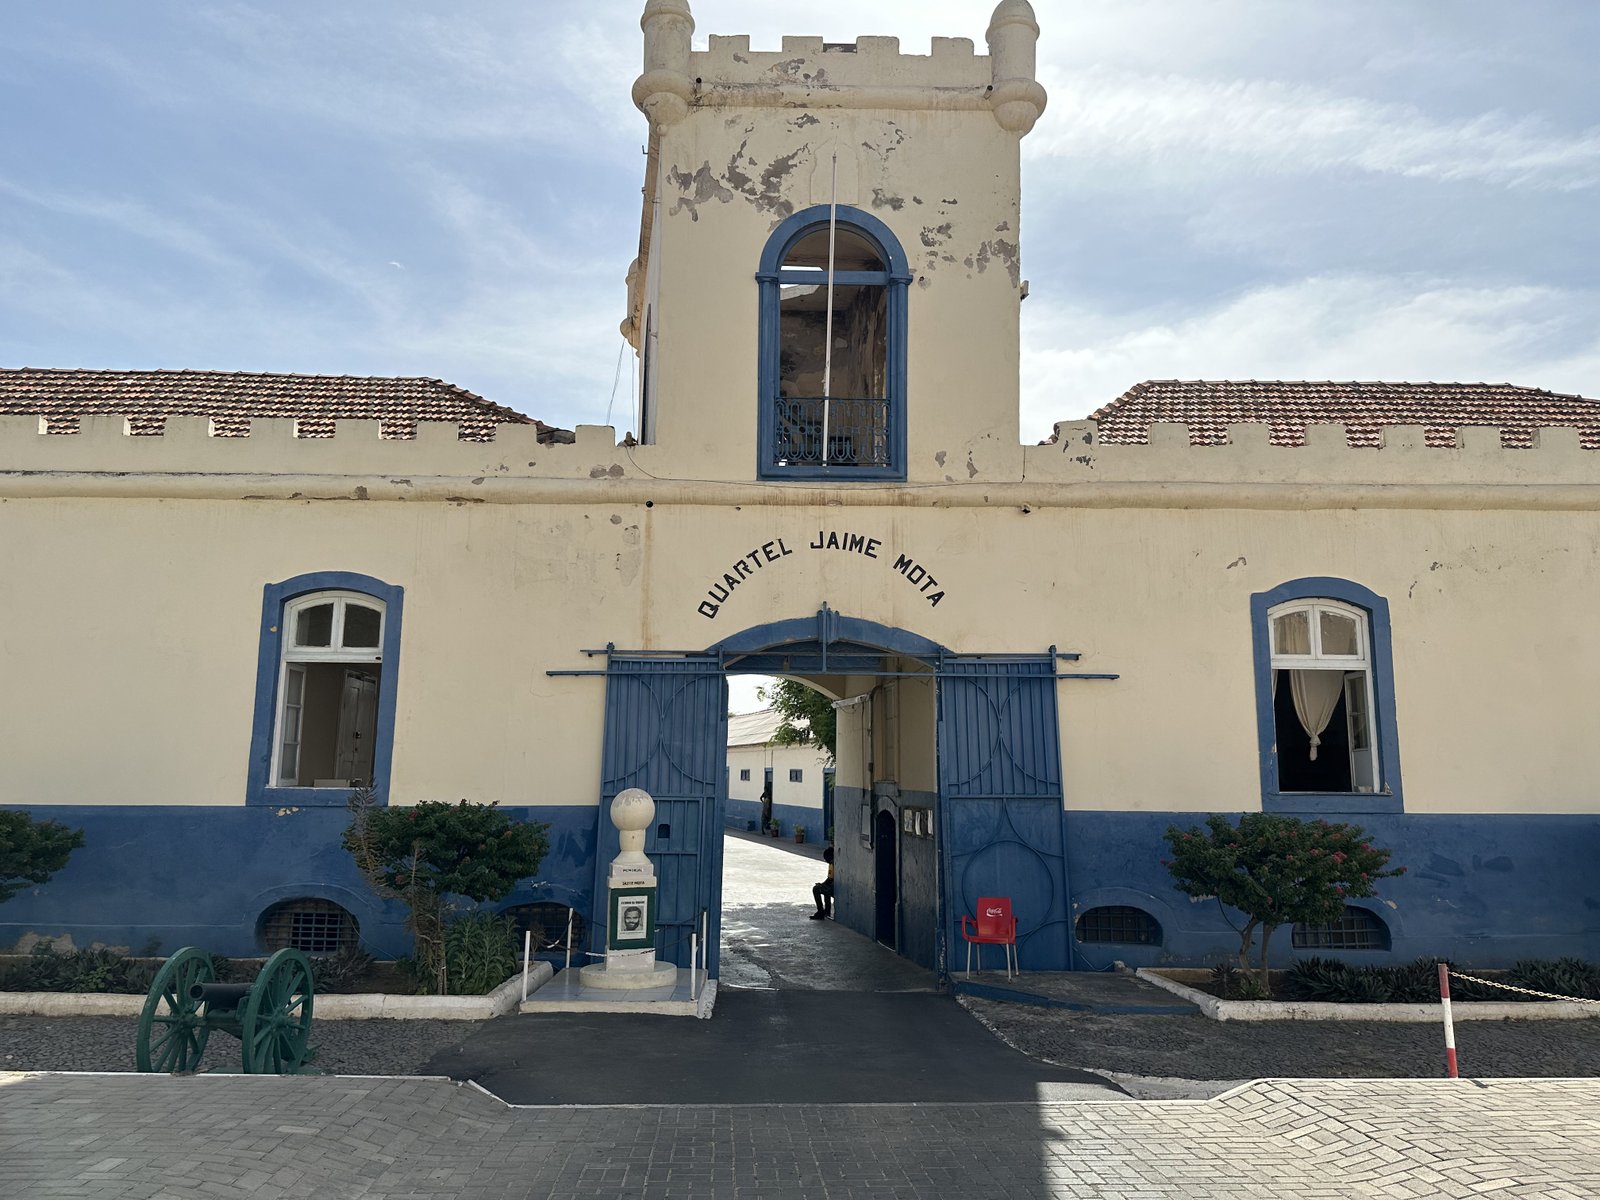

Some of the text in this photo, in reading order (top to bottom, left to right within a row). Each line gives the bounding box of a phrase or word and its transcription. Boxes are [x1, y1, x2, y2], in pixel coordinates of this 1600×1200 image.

[697, 531, 945, 619] QUARTEL JAIME MOTA
